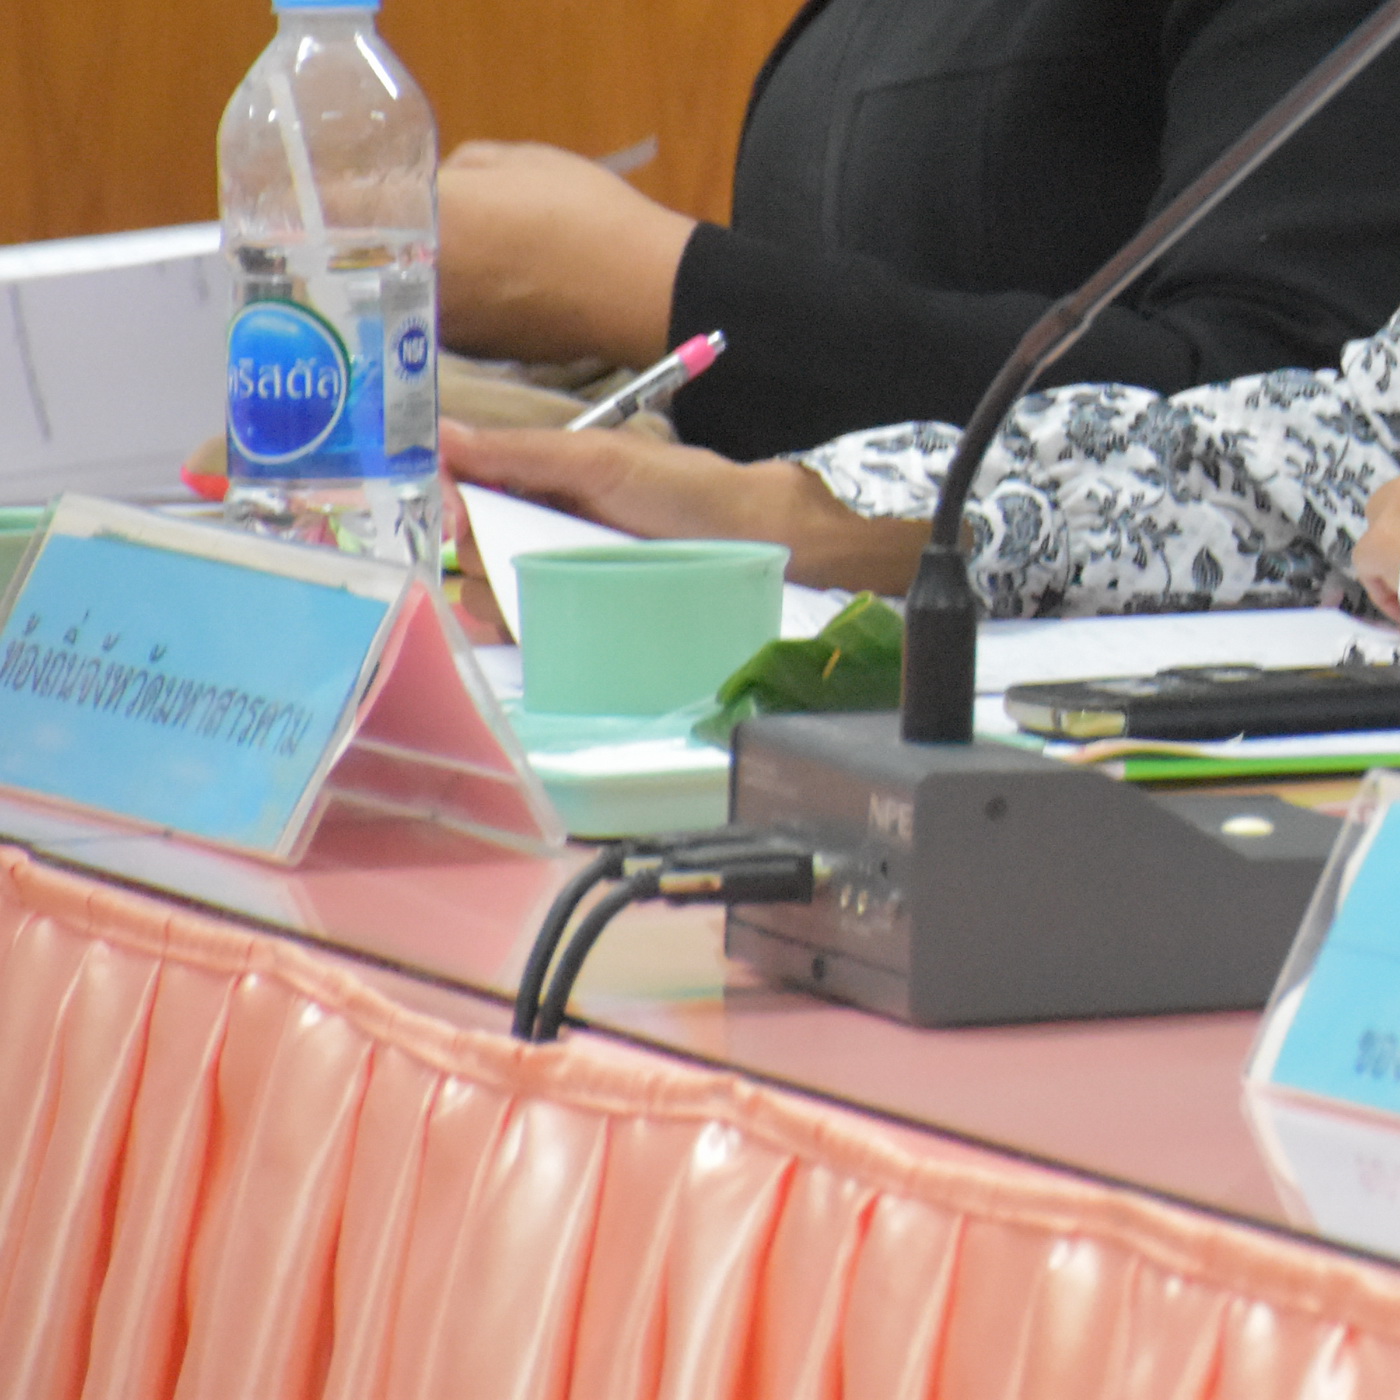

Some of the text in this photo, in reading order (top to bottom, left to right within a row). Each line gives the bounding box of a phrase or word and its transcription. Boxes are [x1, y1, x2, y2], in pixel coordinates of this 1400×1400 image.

[0, 608, 314, 757] ท้องถิ่นจังหวัดมหาสารคาม
